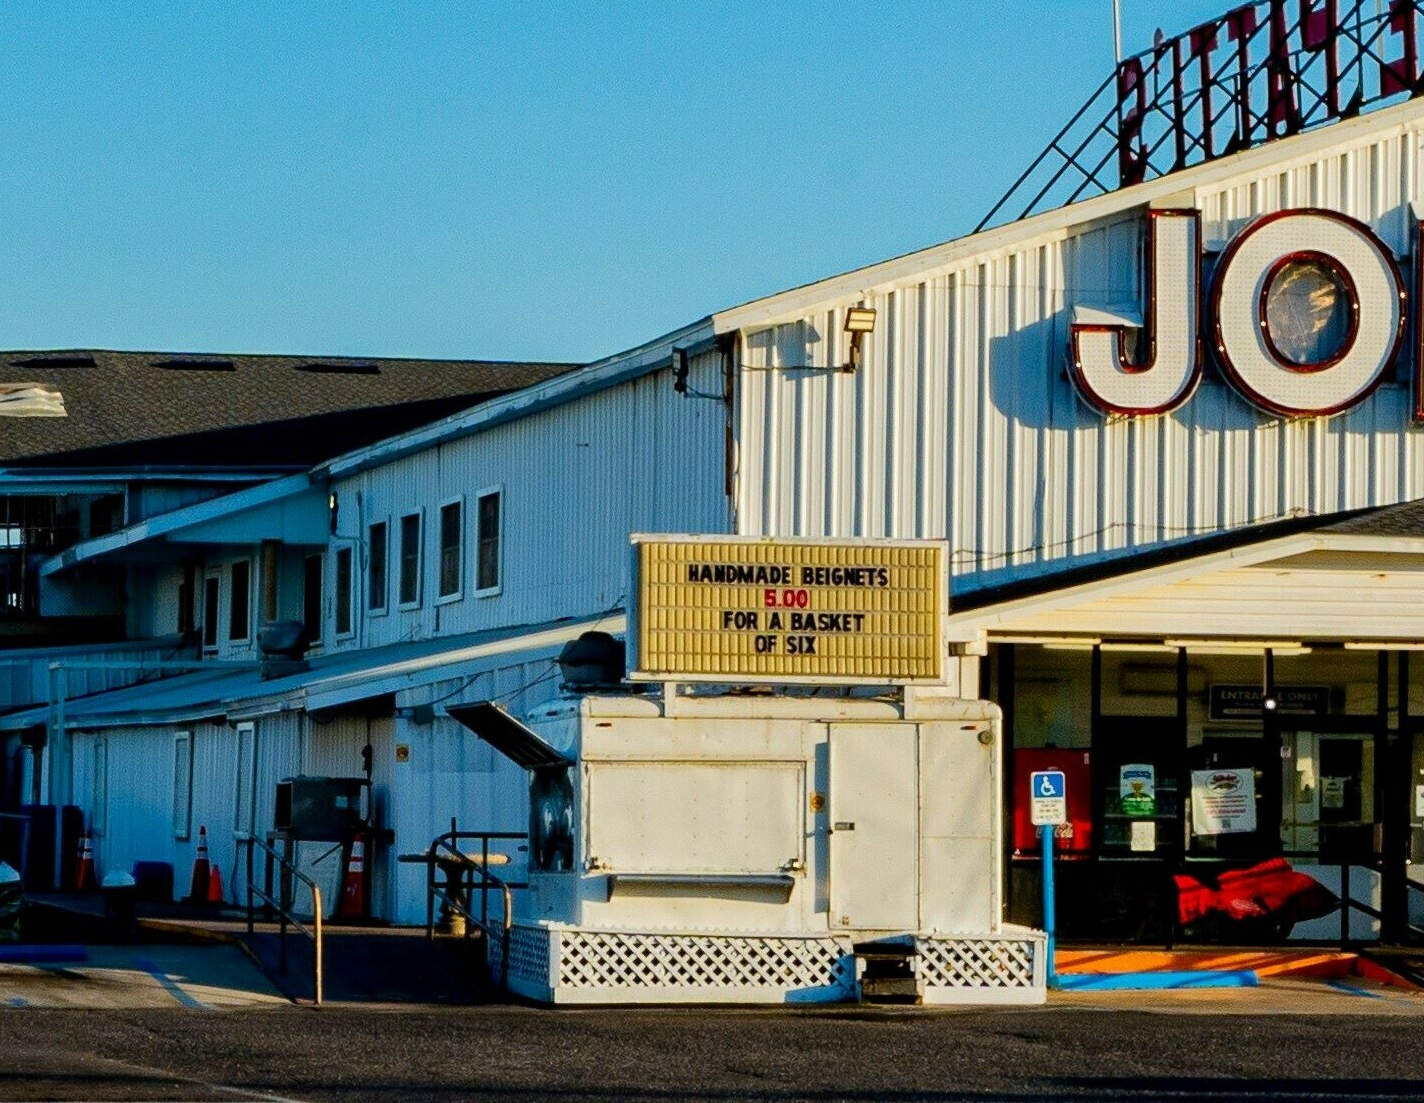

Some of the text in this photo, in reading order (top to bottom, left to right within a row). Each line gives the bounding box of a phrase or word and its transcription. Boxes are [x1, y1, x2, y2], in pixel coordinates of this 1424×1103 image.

[688, 564, 888, 586] HANDMADE BEIGNETS
[764, 589, 808, 608] 5.00
[724, 611, 865, 632] FOR A BASKET
[755, 635, 816, 654] OF SIX
[1221, 690, 1282, 700] ENTRAE
